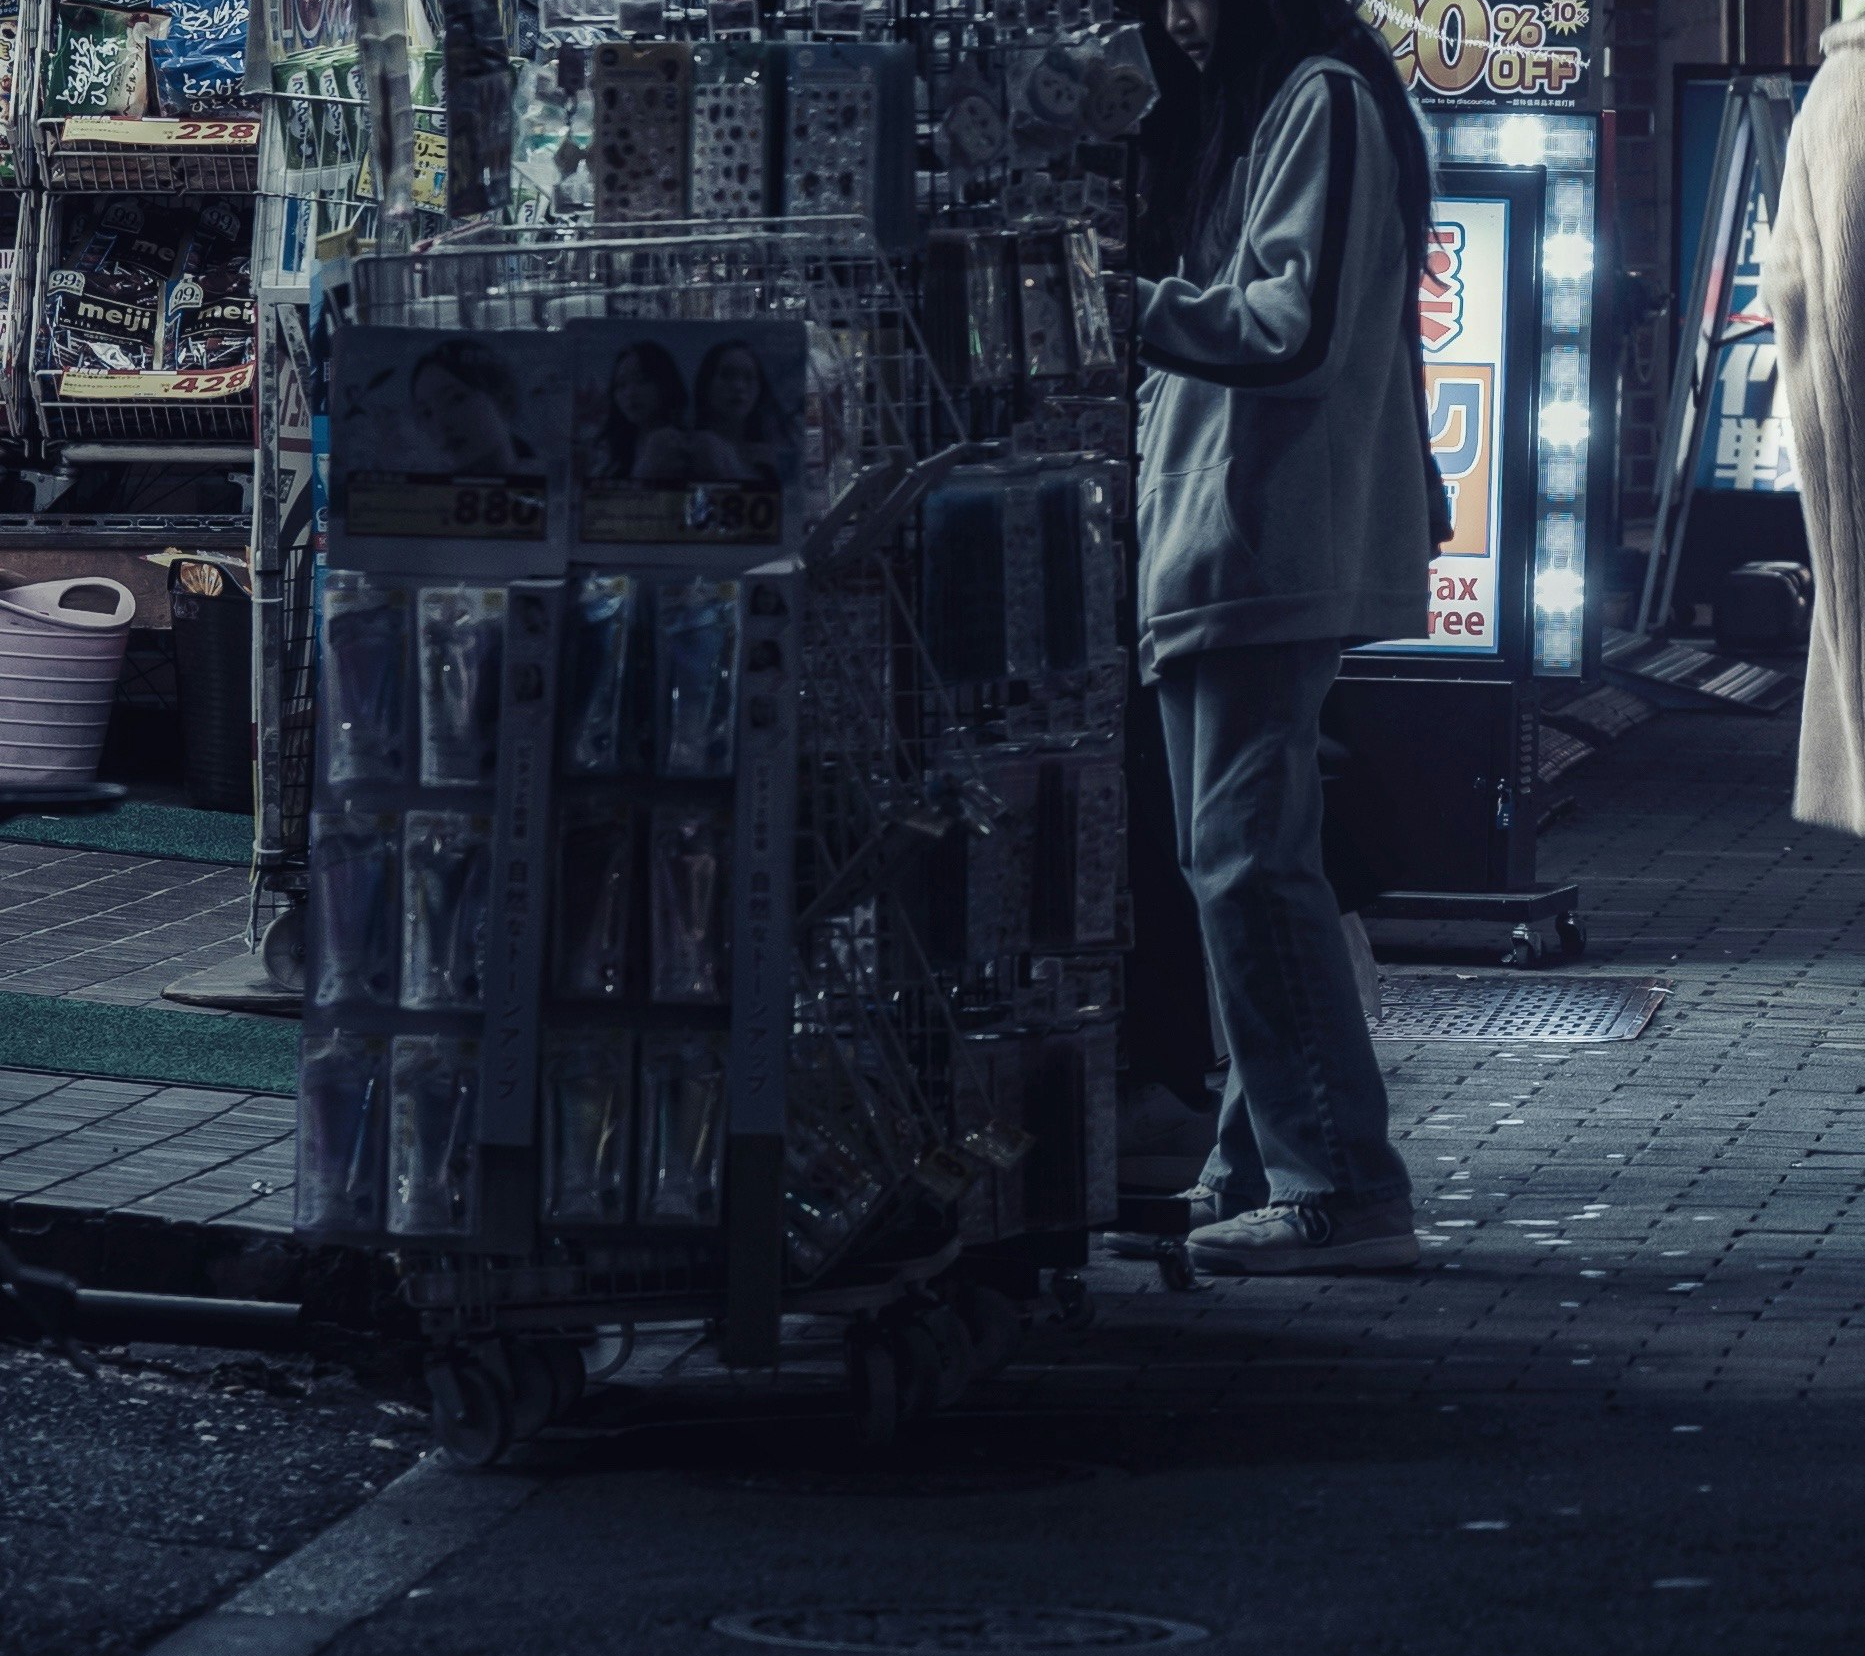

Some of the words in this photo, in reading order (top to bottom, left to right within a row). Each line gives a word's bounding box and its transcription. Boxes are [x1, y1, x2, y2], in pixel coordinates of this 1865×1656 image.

[1486, 47, 1582, 95] OFF
[175, 123, 256, 140] 228
[78, 300, 151, 332] meiji
[172, 370, 248, 394] 428
[1430, 609, 1486, 637] ree
